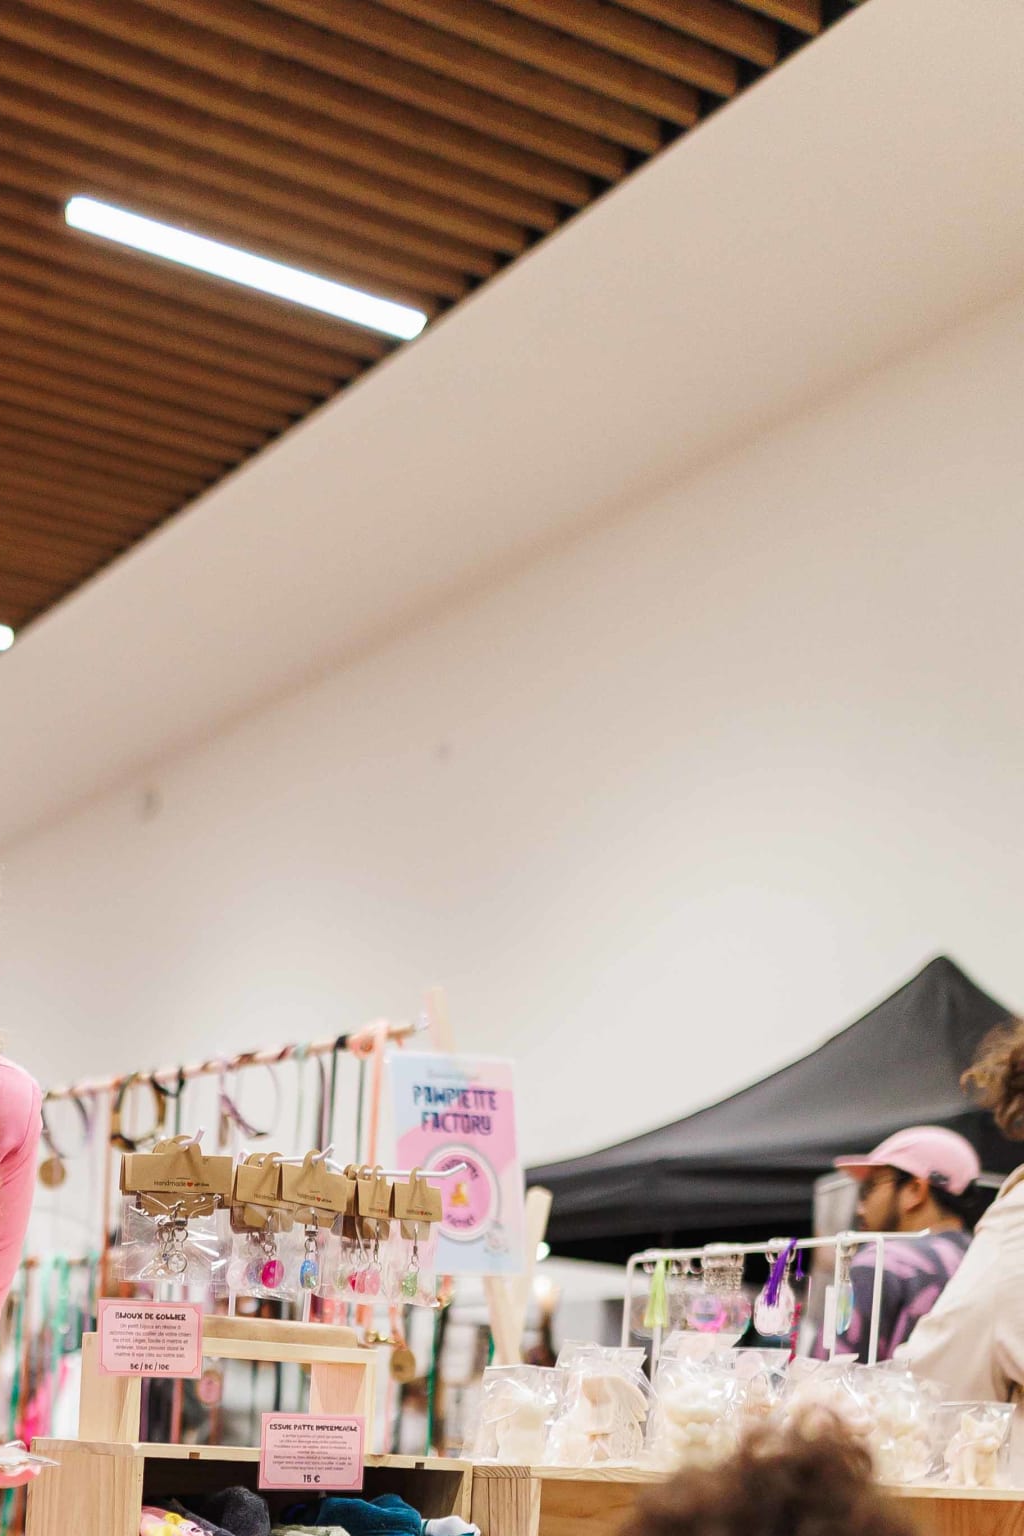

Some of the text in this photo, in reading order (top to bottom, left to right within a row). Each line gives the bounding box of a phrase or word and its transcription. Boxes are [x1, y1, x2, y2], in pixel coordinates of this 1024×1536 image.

[412, 1084, 498, 1111] PAWPIETTE
[421, 1111, 492, 1135] FACTORY
[115, 1312, 143, 1320] BIJOUX
[155, 1313, 186, 1321] COLLIER
[303, 1474, 321, 1483] 15 €
